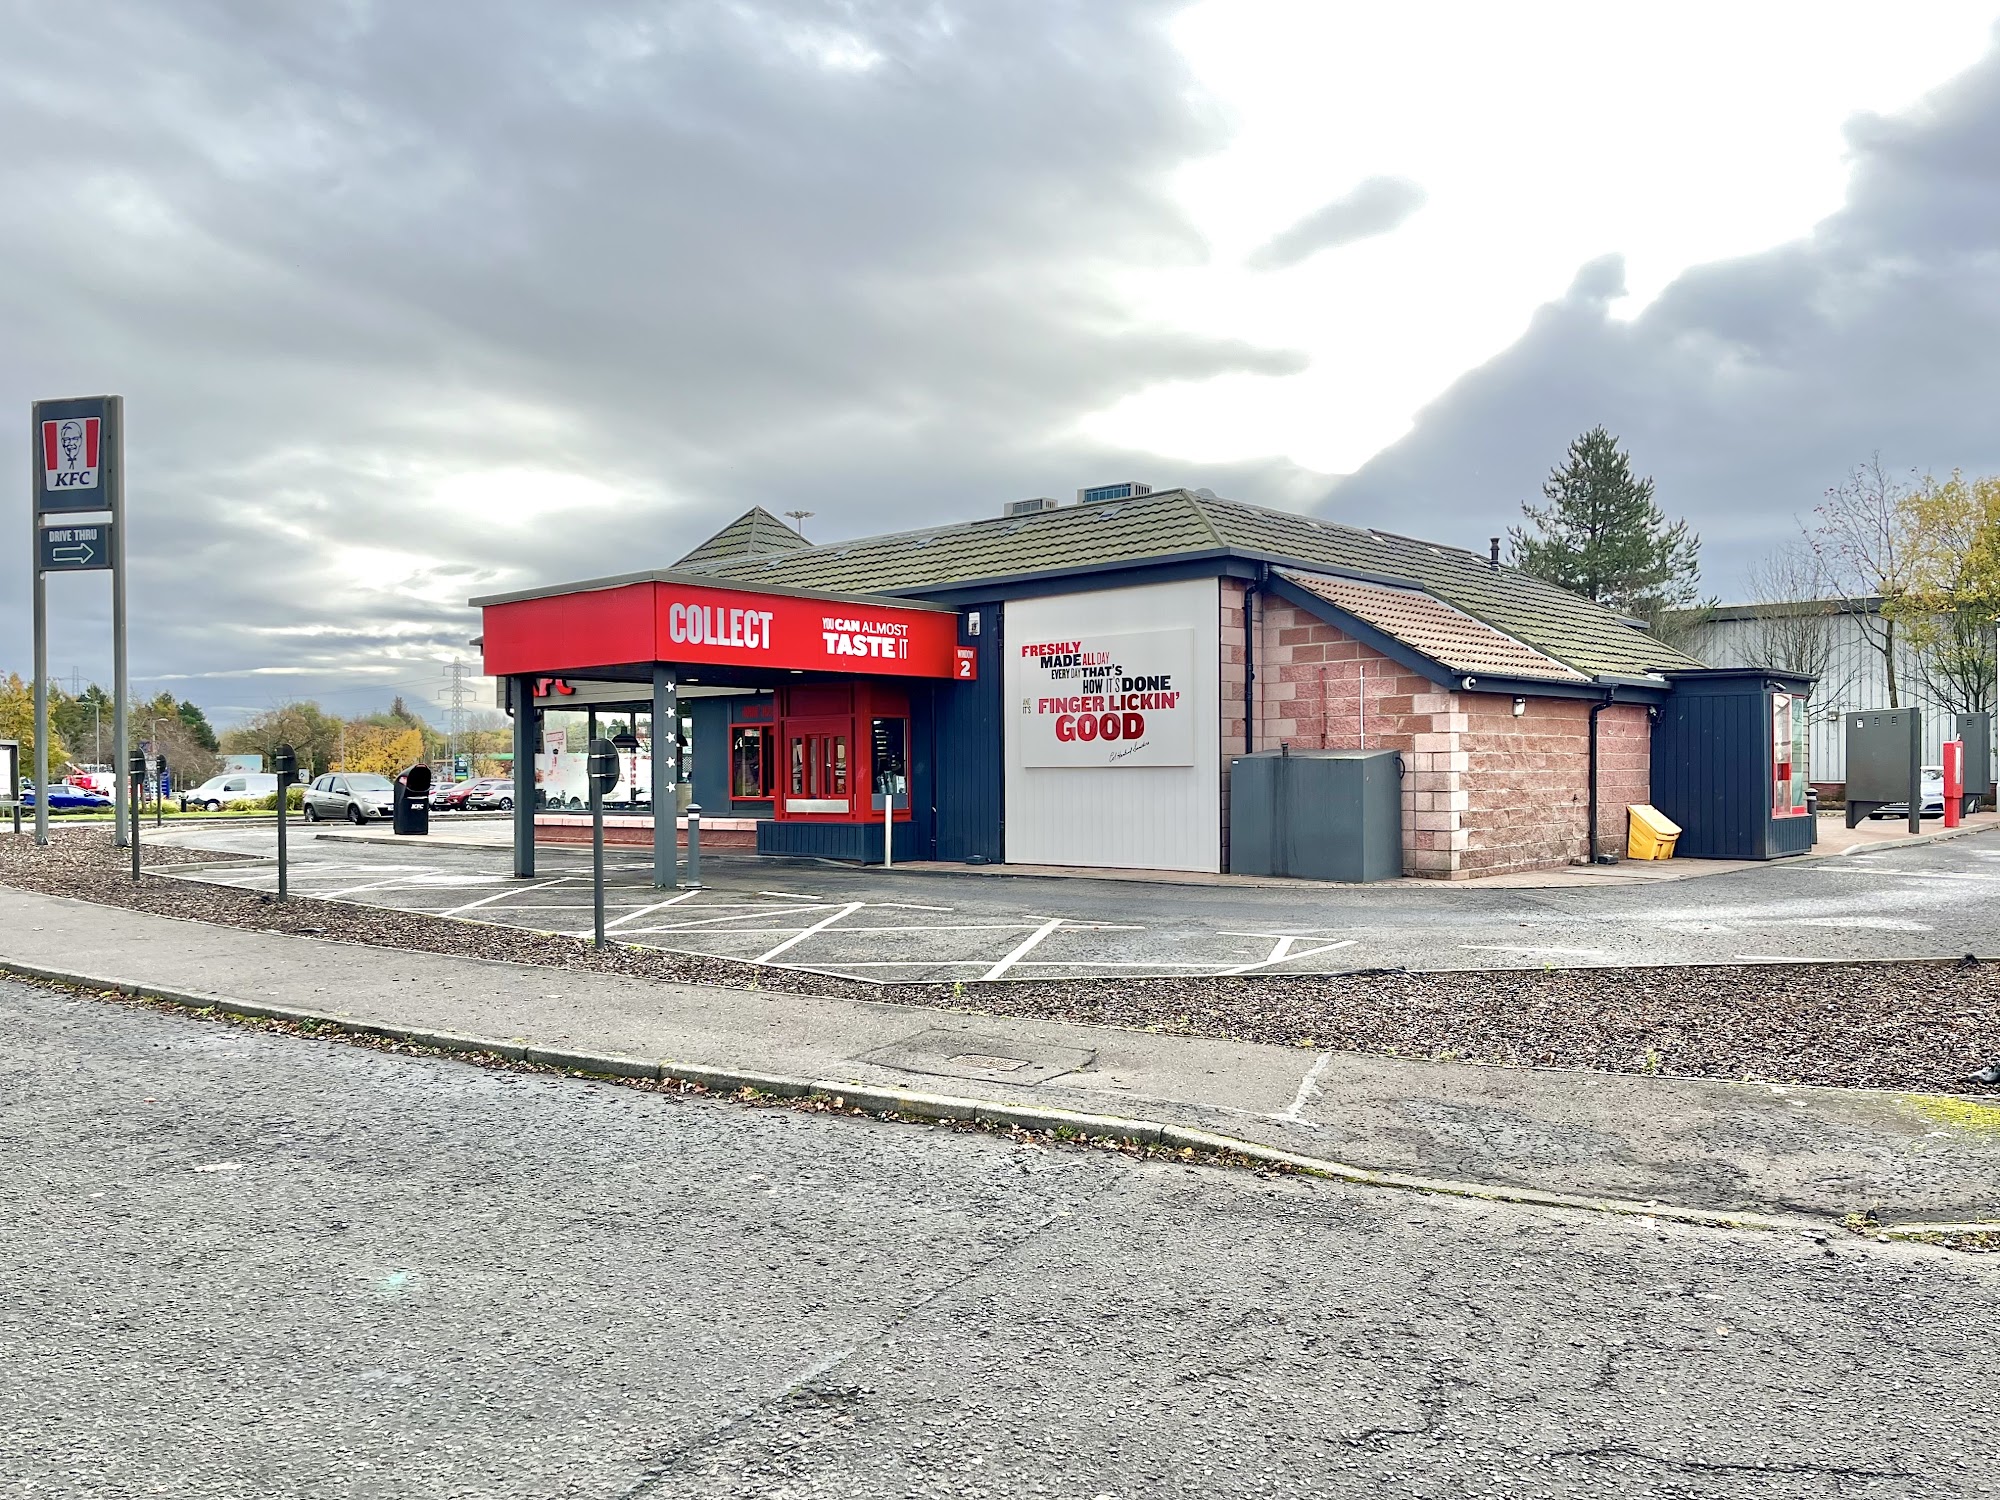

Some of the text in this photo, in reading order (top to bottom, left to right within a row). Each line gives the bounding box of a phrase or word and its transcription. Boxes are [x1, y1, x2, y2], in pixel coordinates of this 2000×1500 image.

[55, 471, 90, 487] KFC
[48, 529, 98, 542] DRIVE THRU
[669, 602, 774, 649] COLLECT
[821, 617, 908, 636] YOU CAN ALMOST
[822, 632, 908, 659] TASTE IT
[1021, 641, 1081, 657] FRESHLY
[960, 660, 971, 677] 2
[1040, 651, 1110, 669] MADE ALL DAY
[1051, 664, 1122, 680] EVERY DAY THAT'S
[1083, 675, 1171, 694] HOW IT'S DONE
[1038, 692, 1180, 714] FINGER LICKIN'
[1055, 712, 1145, 742] GOOD
